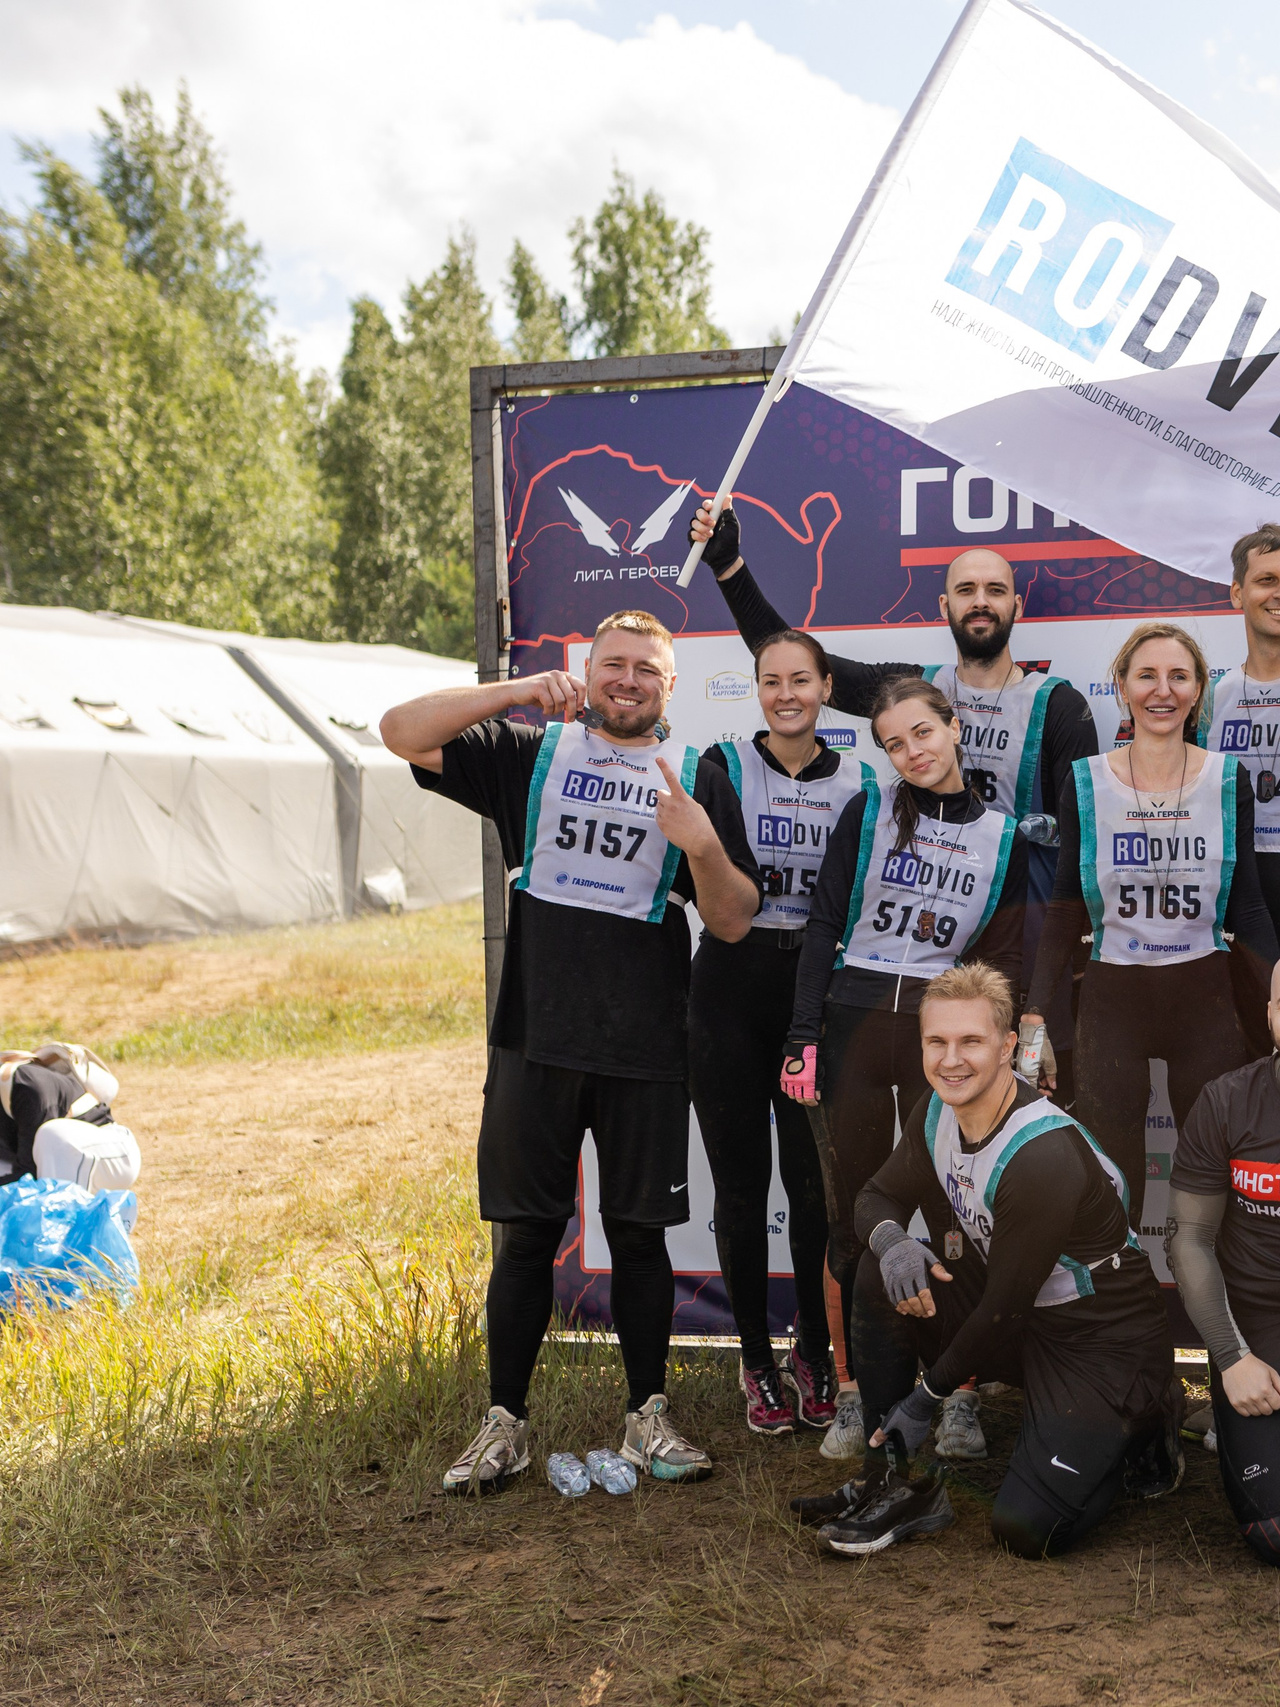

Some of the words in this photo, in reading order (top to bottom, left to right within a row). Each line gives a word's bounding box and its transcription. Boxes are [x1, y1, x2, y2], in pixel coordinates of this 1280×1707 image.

[931, 300, 1015, 356] НАДЕЖНОСТЬ
[1015, 345, 1047, 373] ДЛЯ
[1043, 361, 1163, 438] ПРОМЫШЛЕННОСТИ,
[1163, 424, 1273, 493] БЛАГОСОСТОЯНИЕ
[574, 568, 614, 583] ЛИГА
[619, 565, 680, 580] ГЕРОЕВ
[708, 680, 750, 691] Московский
[712, 689, 748, 697] КАРТОФЕЛЬ
[974, 704, 1003, 713] ГЕРОЕВ
[1238, 698, 1261, 706] ГОНКА
[960, 724, 1010, 751] DVIG
[588, 756, 614, 766] ГОНКА
[616, 757, 648, 773] ГЕРОЕВ
[564, 772, 660, 808] RODVIG
[772, 796, 800, 805] ГОНКА
[801, 798, 831, 808] ГЕРОЕВ
[1126, 811, 1155, 819] ГОНКА
[1157, 810, 1190, 818] ГЕРОЕВ
[555, 814, 648, 862] 5157
[761, 818, 833, 849] RODVI
[936, 838, 967, 853] ГЕРОЕВ
[1116, 836, 1207, 862] RODVIG
[886, 853, 976, 897] RODVIG
[572, 876, 626, 894] ГАЗПРОМБАНК
[1117, 884, 1202, 920] 5165
[1143, 942, 1191, 952] ГАЗПРОМБАНК
